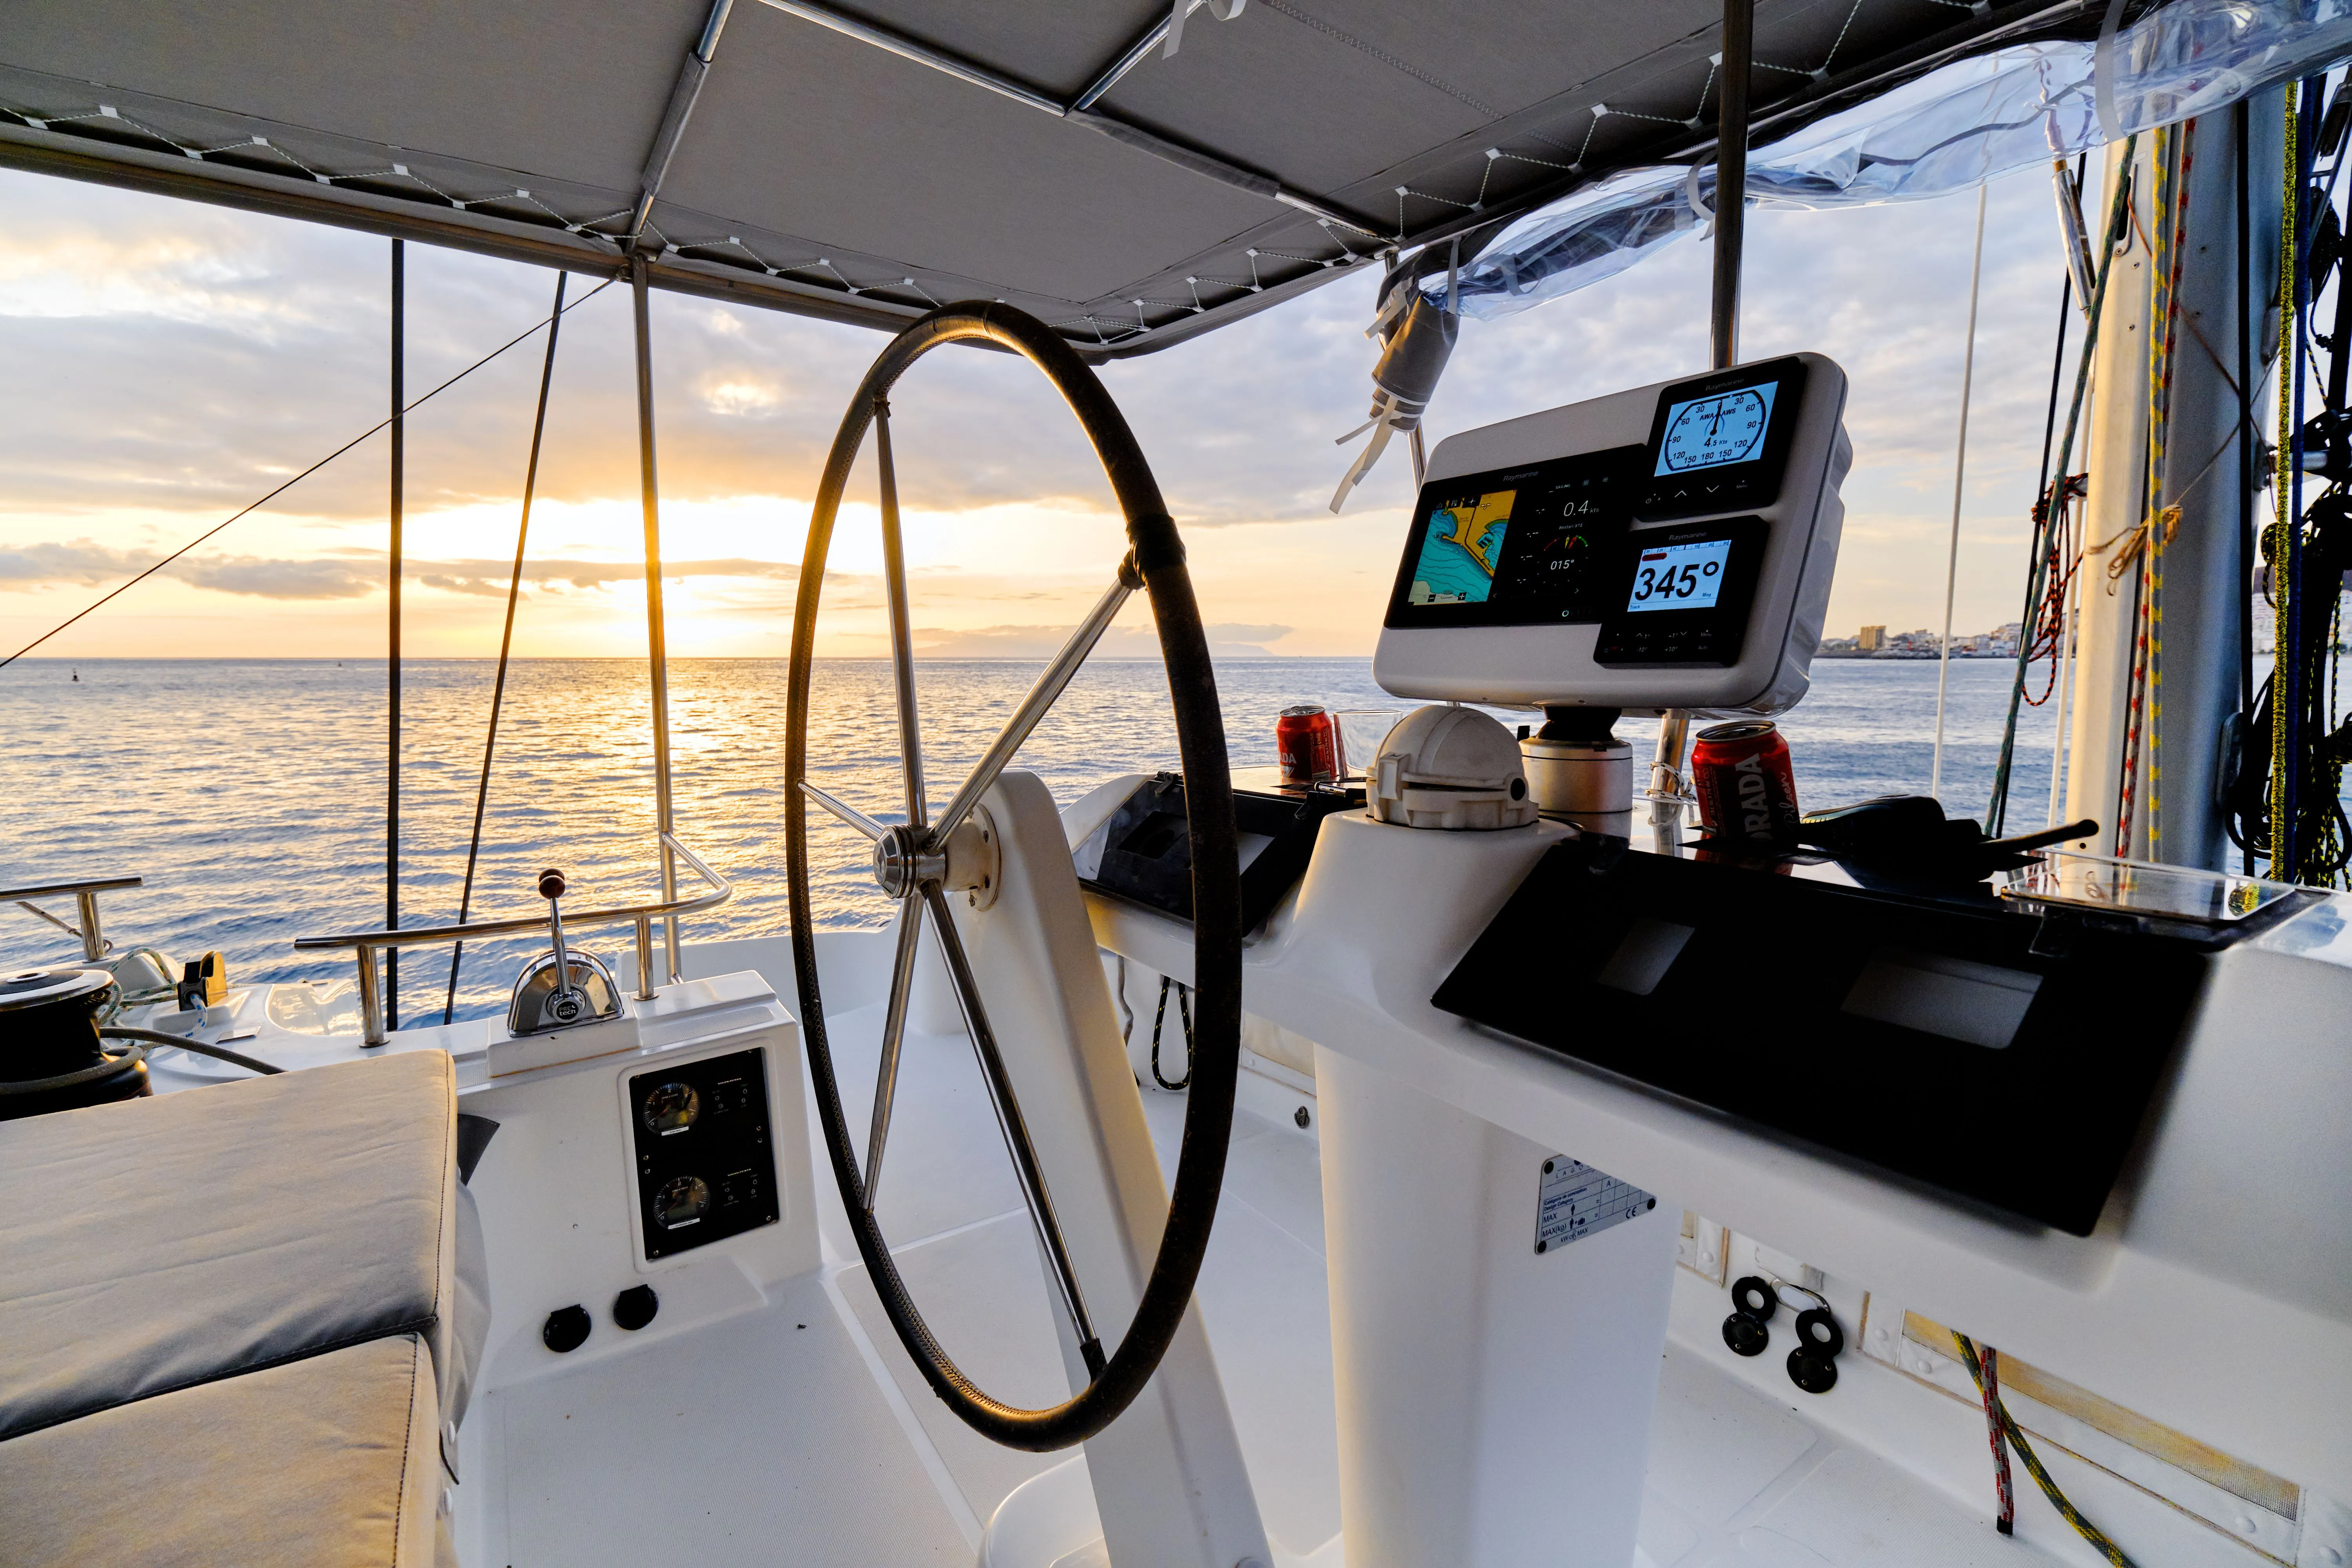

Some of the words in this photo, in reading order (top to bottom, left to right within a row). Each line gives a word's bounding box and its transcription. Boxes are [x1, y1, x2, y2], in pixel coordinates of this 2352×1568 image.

[1704, 437, 1717, 447] 4.5
[1734, 439, 1747, 448] 120
[1673, 451, 1685, 459] 120
[1701, 452, 1714, 460] 180
[1719, 449, 1732, 457] 150
[1684, 456, 1696, 464] 150
[1503, 471, 1538, 481] Raymarine
[1563, 500, 1588, 517] 0.4
[1668, 532, 1707, 541] Raymarine
[1635, 561, 1719, 601] 345°
[1281, 752, 1297, 764] DA
[1556, 1165, 1590, 1178] LAGO
[1543, 1212, 1557, 1223] MAX
[1626, 1206, 1637, 1219] CE
[1542, 1223, 1566, 1238] MAX(kg)
[1577, 1227, 1588, 1236] MAX
